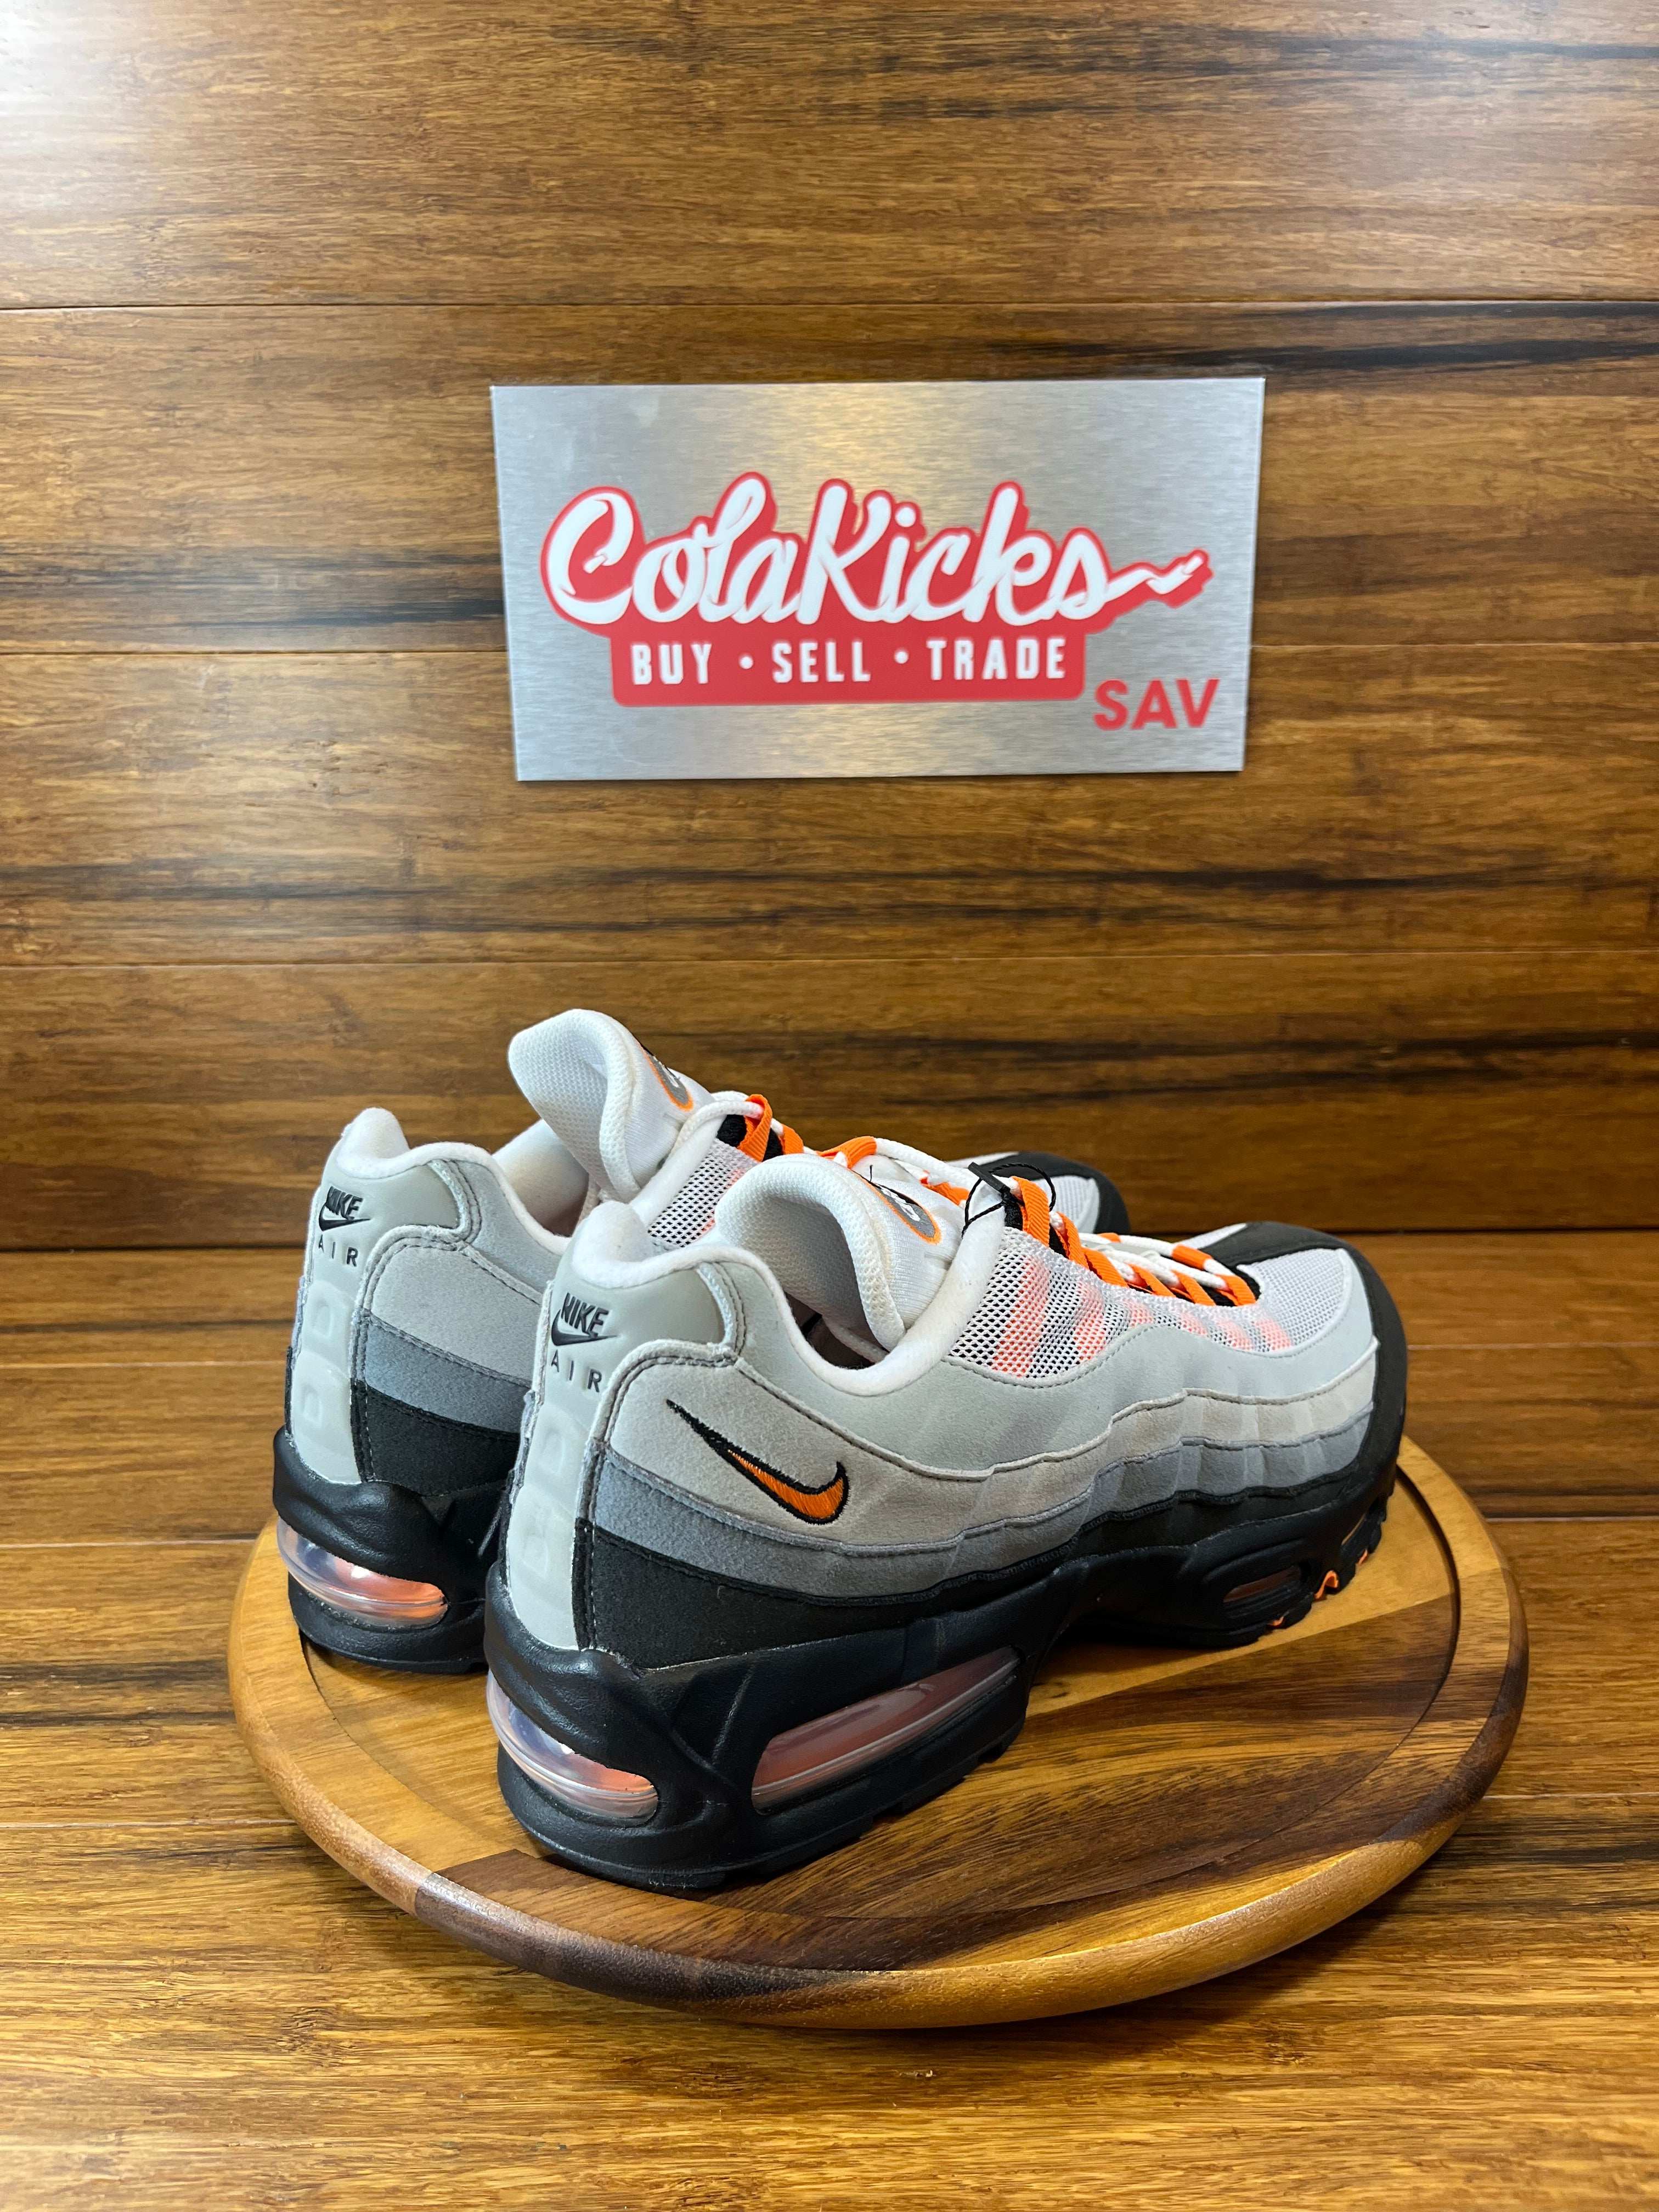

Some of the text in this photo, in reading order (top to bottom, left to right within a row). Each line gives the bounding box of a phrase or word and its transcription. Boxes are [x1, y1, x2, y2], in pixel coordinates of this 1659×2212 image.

[548, 476, 1204, 627] ColaKicks
[632, 637, 1065, 685] BUY SELL TRADE
[1094, 679, 1219, 730] SAV
[326, 1186, 363, 1220] NIKE
[318, 1234, 358, 1267] AIR
[561, 1292, 609, 1338] NIKE
[551, 1350, 602, 1393] AIR
